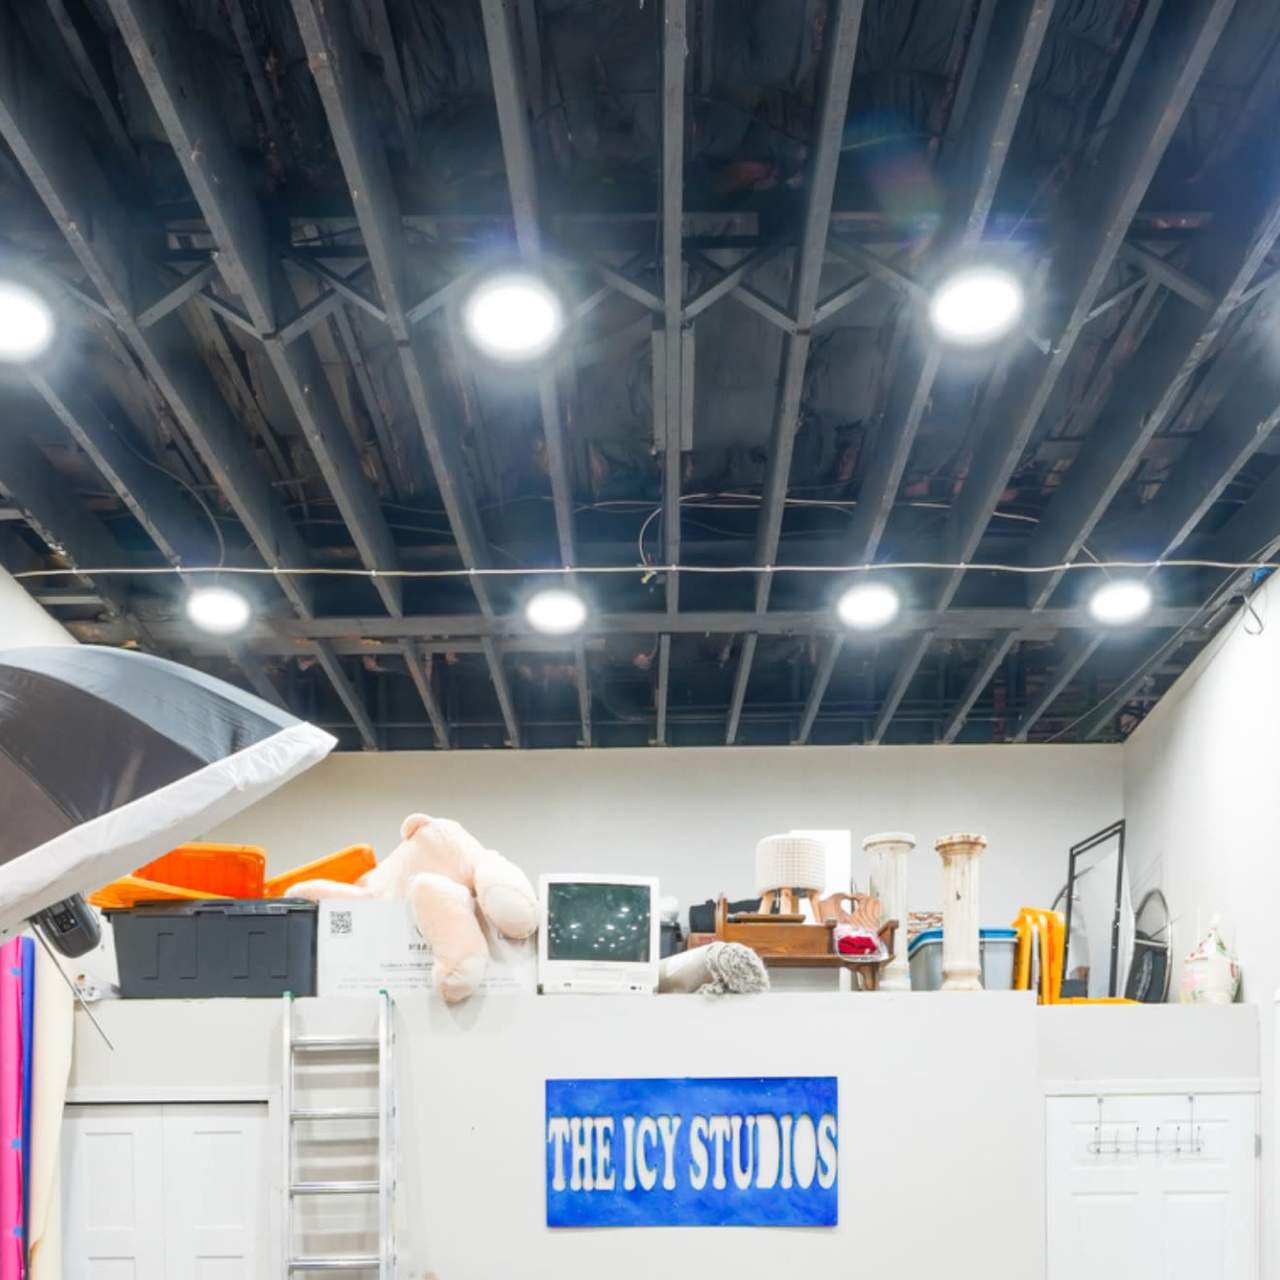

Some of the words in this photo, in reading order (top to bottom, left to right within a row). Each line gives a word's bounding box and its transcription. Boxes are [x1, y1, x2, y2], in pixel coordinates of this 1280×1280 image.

[547, 1116, 615, 1191] THE
[623, 1115, 682, 1191] ICY
[689, 1114, 838, 1190] STUDIOS
